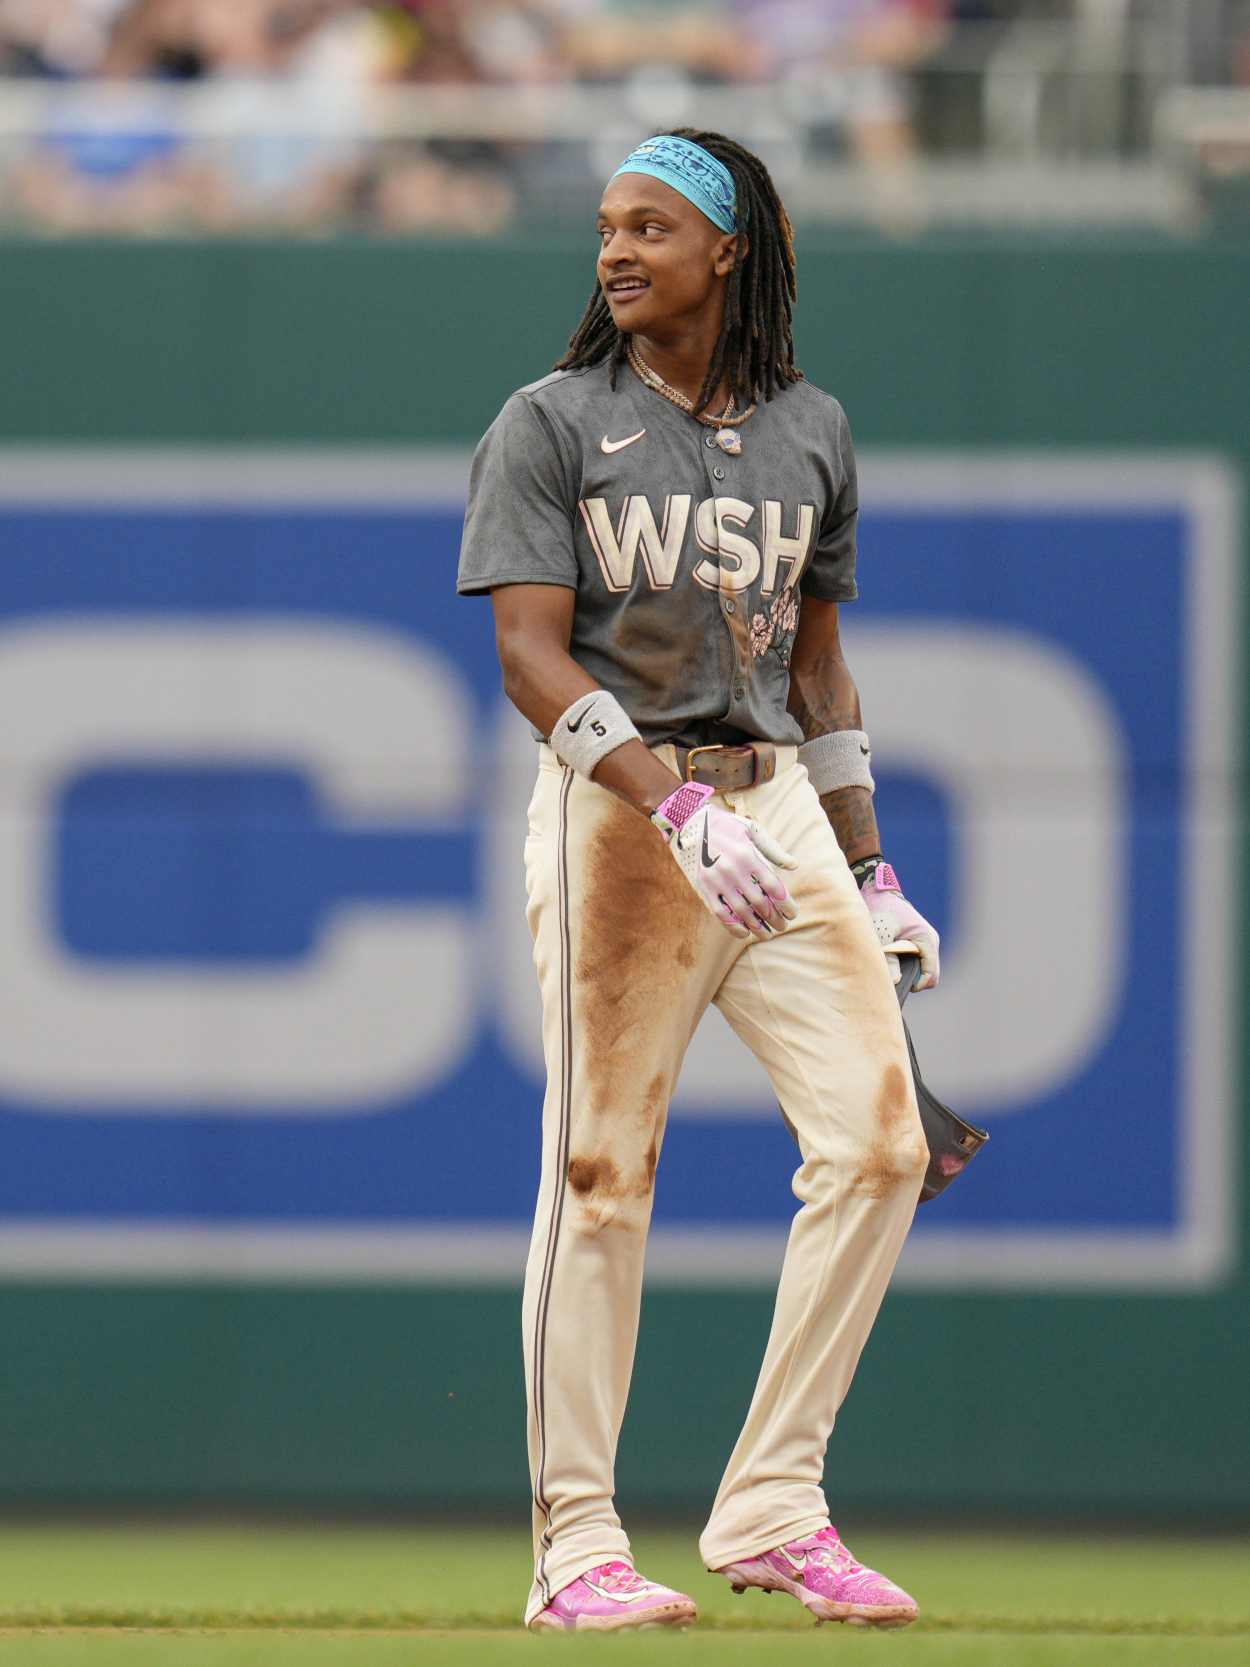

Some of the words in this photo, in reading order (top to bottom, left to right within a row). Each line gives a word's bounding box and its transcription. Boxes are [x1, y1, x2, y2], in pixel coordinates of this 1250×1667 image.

[578, 493, 817, 596] WSH
[591, 720, 607, 737] 5
[764, 758, 772, 779] 5
